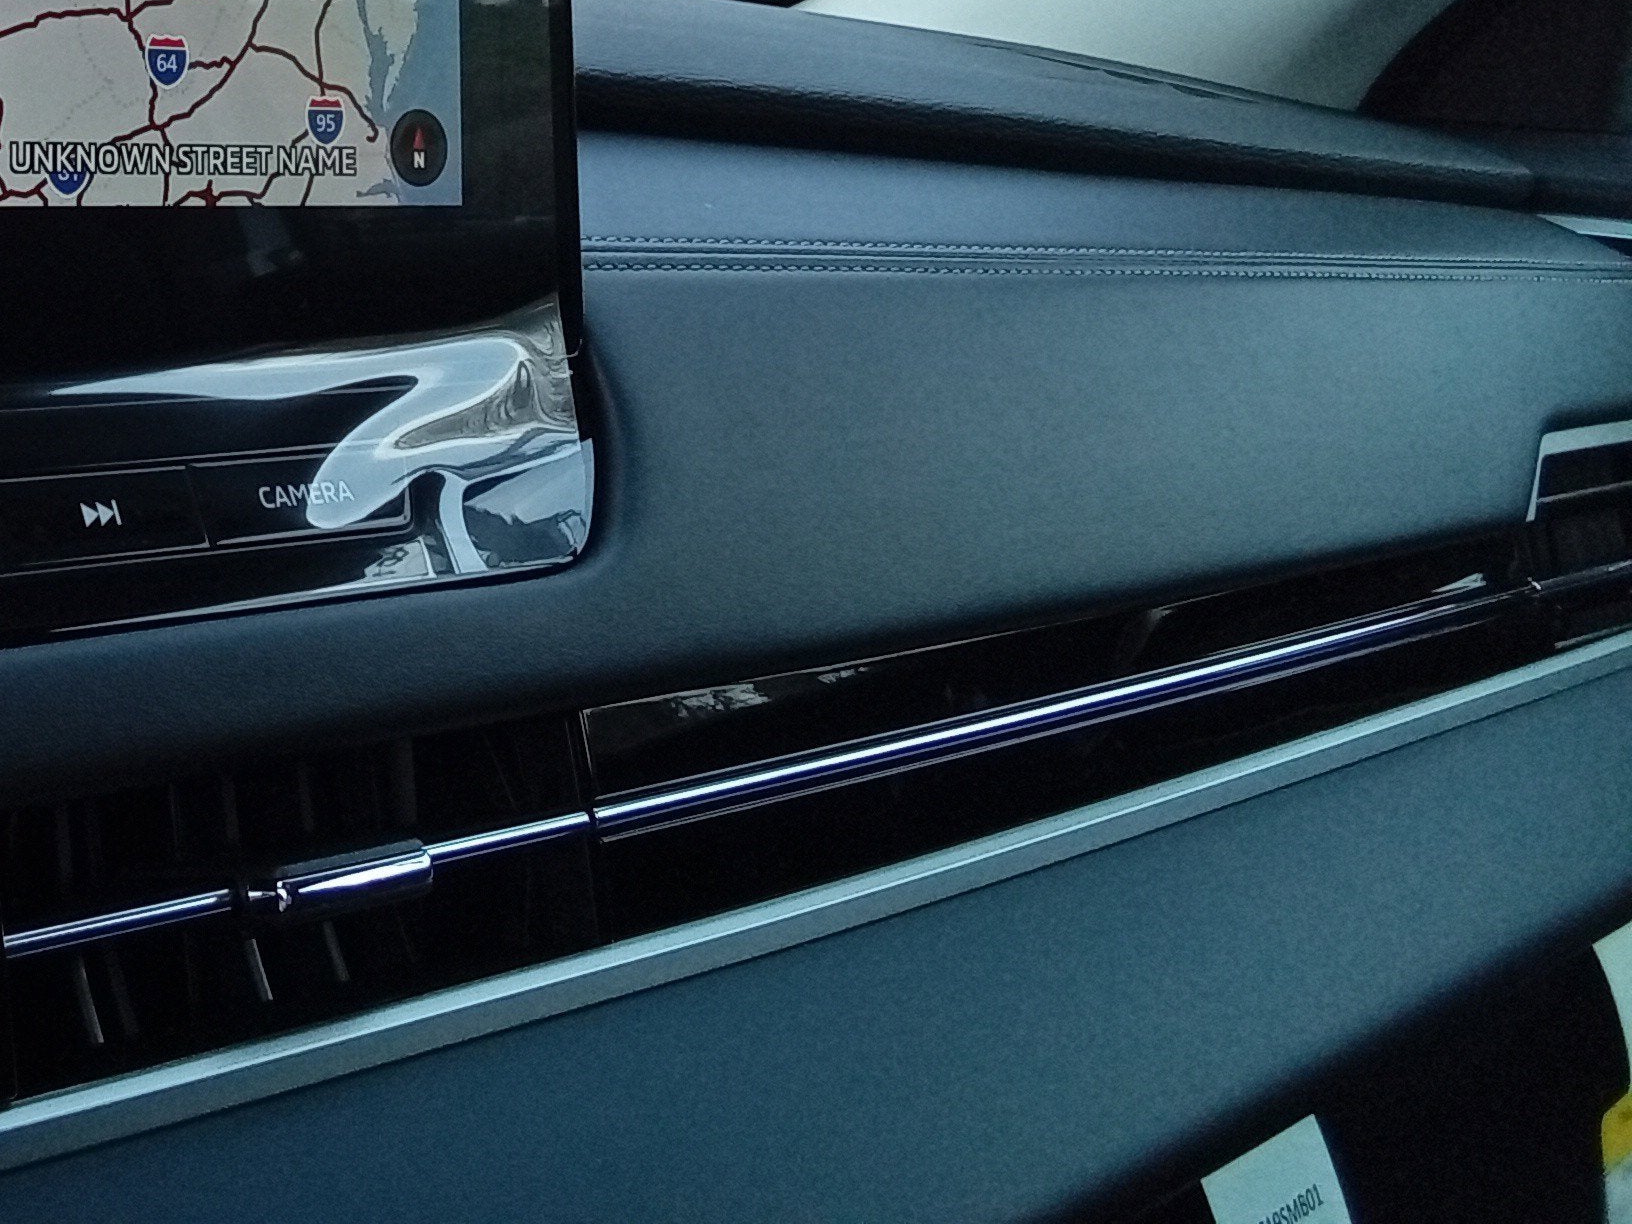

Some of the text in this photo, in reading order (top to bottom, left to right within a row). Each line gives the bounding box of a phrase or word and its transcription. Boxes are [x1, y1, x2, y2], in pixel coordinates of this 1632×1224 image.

[156, 53, 177, 73] 64
[315, 114, 335, 132] 95
[10, 144, 356, 175] UNKNOWN STREET NAME
[413, 151, 425, 169] N
[258, 480, 355, 509] CAMERA
